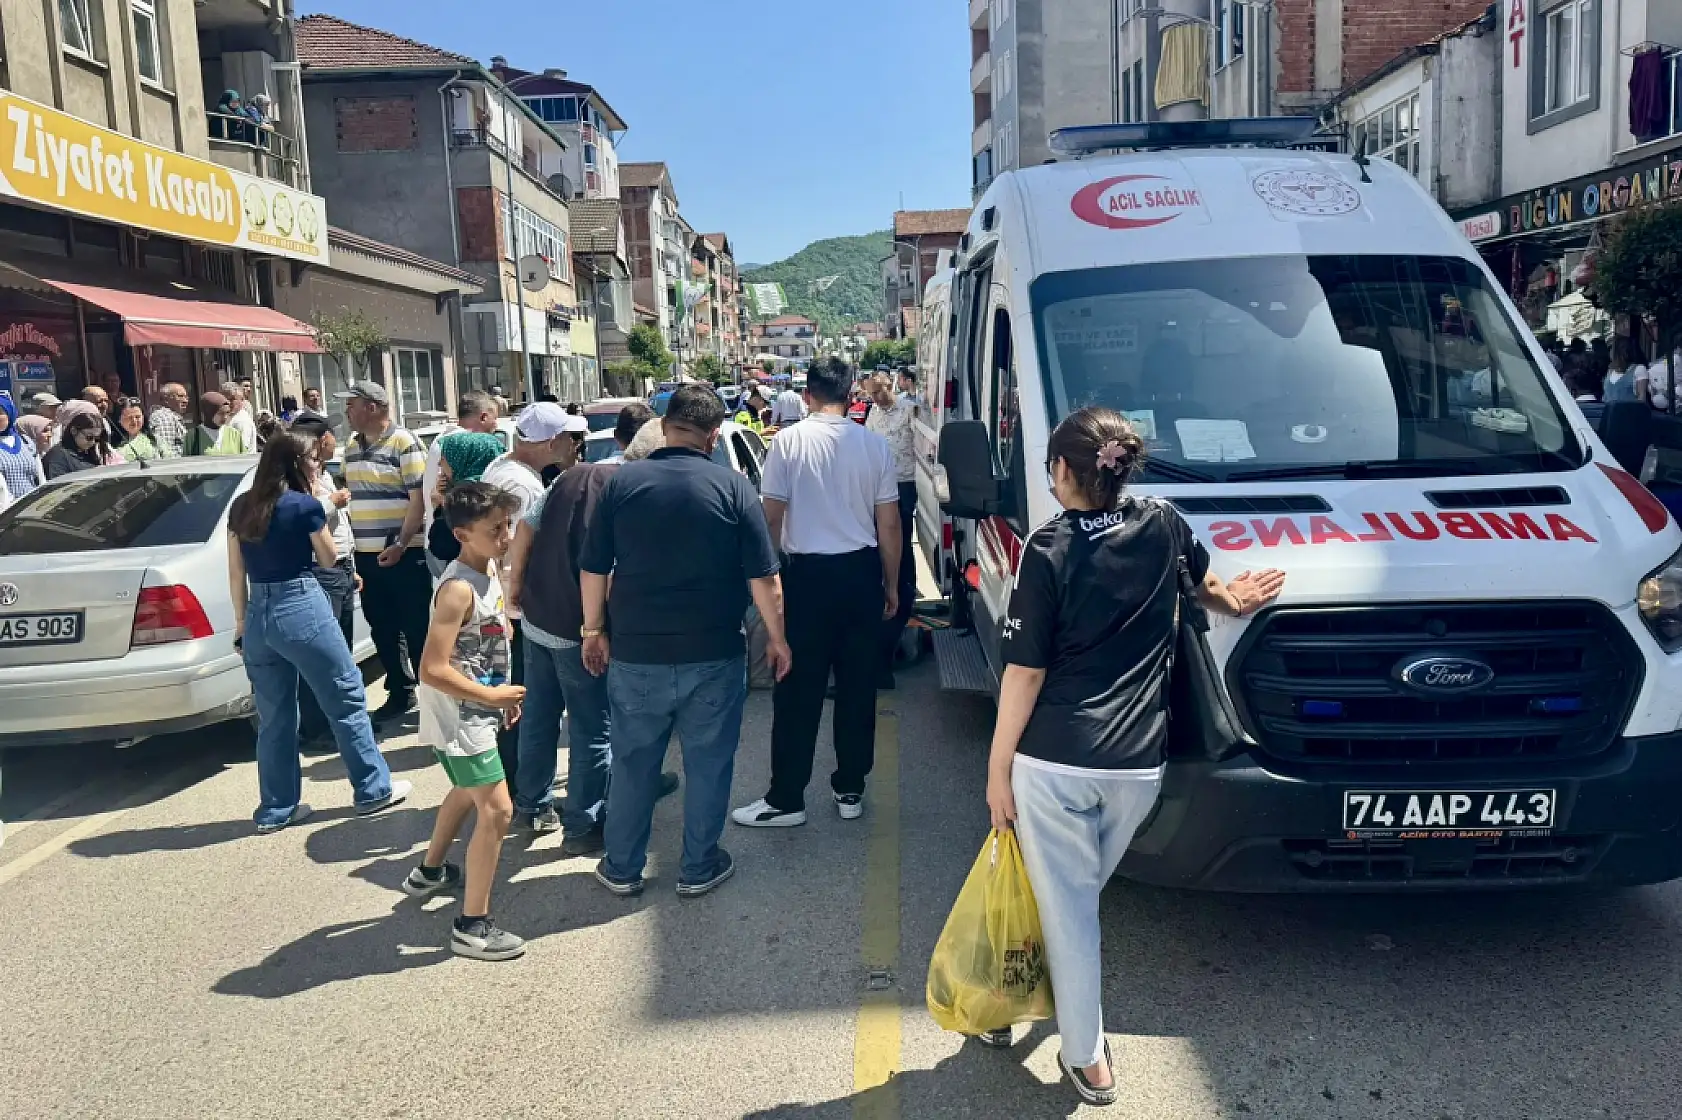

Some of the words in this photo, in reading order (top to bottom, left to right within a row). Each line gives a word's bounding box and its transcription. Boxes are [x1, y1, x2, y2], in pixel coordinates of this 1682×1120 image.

[7, 104, 138, 204] Ziyafet
[144, 151, 235, 226] Kasabı
[1144, 185, 1201, 208] SAĞLIK
[1510, 186, 1572, 233] DÜĞÜN
[1079, 510, 1123, 532] beko
[0, 618, 29, 640] AS
[37, 616, 75, 638] 903
[1424, 663, 1475, 686] Ford
[1349, 794, 1395, 827] 74
[1402, 794, 1472, 826] AAP
[1480, 793, 1550, 826] 443
